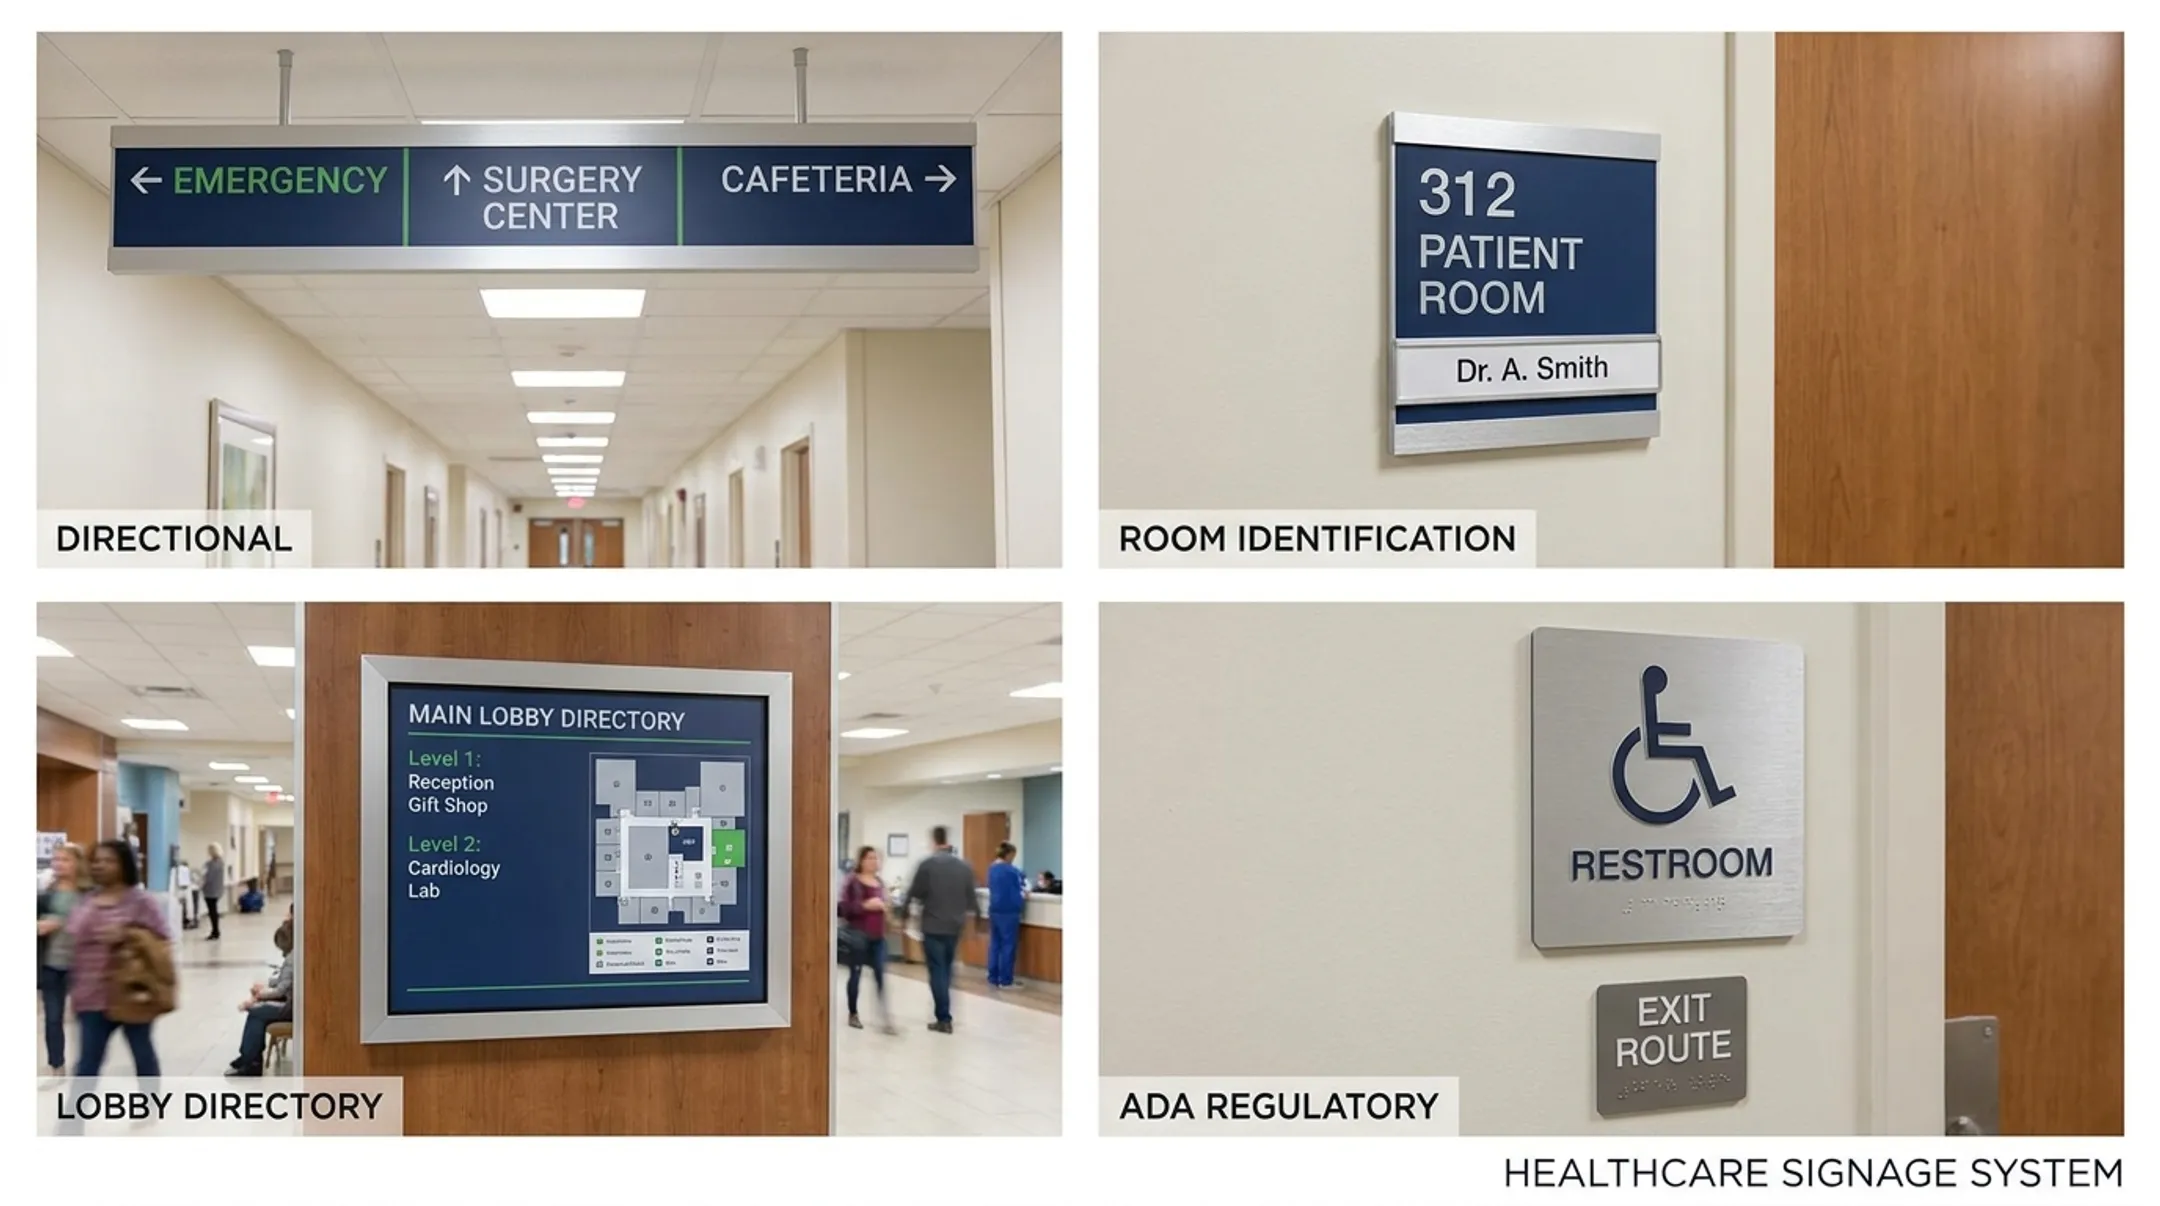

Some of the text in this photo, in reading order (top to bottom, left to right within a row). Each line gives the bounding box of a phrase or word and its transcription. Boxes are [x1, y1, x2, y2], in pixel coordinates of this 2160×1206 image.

[175, 166, 388, 193] EMERGENCY
[484, 166, 642, 193] SURGERY
[722, 166, 912, 192] CAFETERIA
[1420, 168, 1514, 217] 312
[484, 203, 618, 229] CENTER
[1421, 234, 1583, 269] PATIENT
[1420, 280, 1544, 314] ROOM
[1458, 355, 1607, 382] Dr. A. Smith
[410, 704, 685, 730] MAIN LOBBY DIRECTORY
[410, 750, 480, 767] Level 1:
[409, 774, 494, 793] Reception
[409, 796, 487, 816] Gift Shop
[410, 835, 480, 852] Level 2:
[409, 860, 500, 879] Cardiology
[1572, 847, 1774, 881] RESTROOM
[409, 883, 440, 898] Lab
[1639, 993, 1711, 1026] EXIT
[1617, 1030, 1731, 1066] ROUTE
